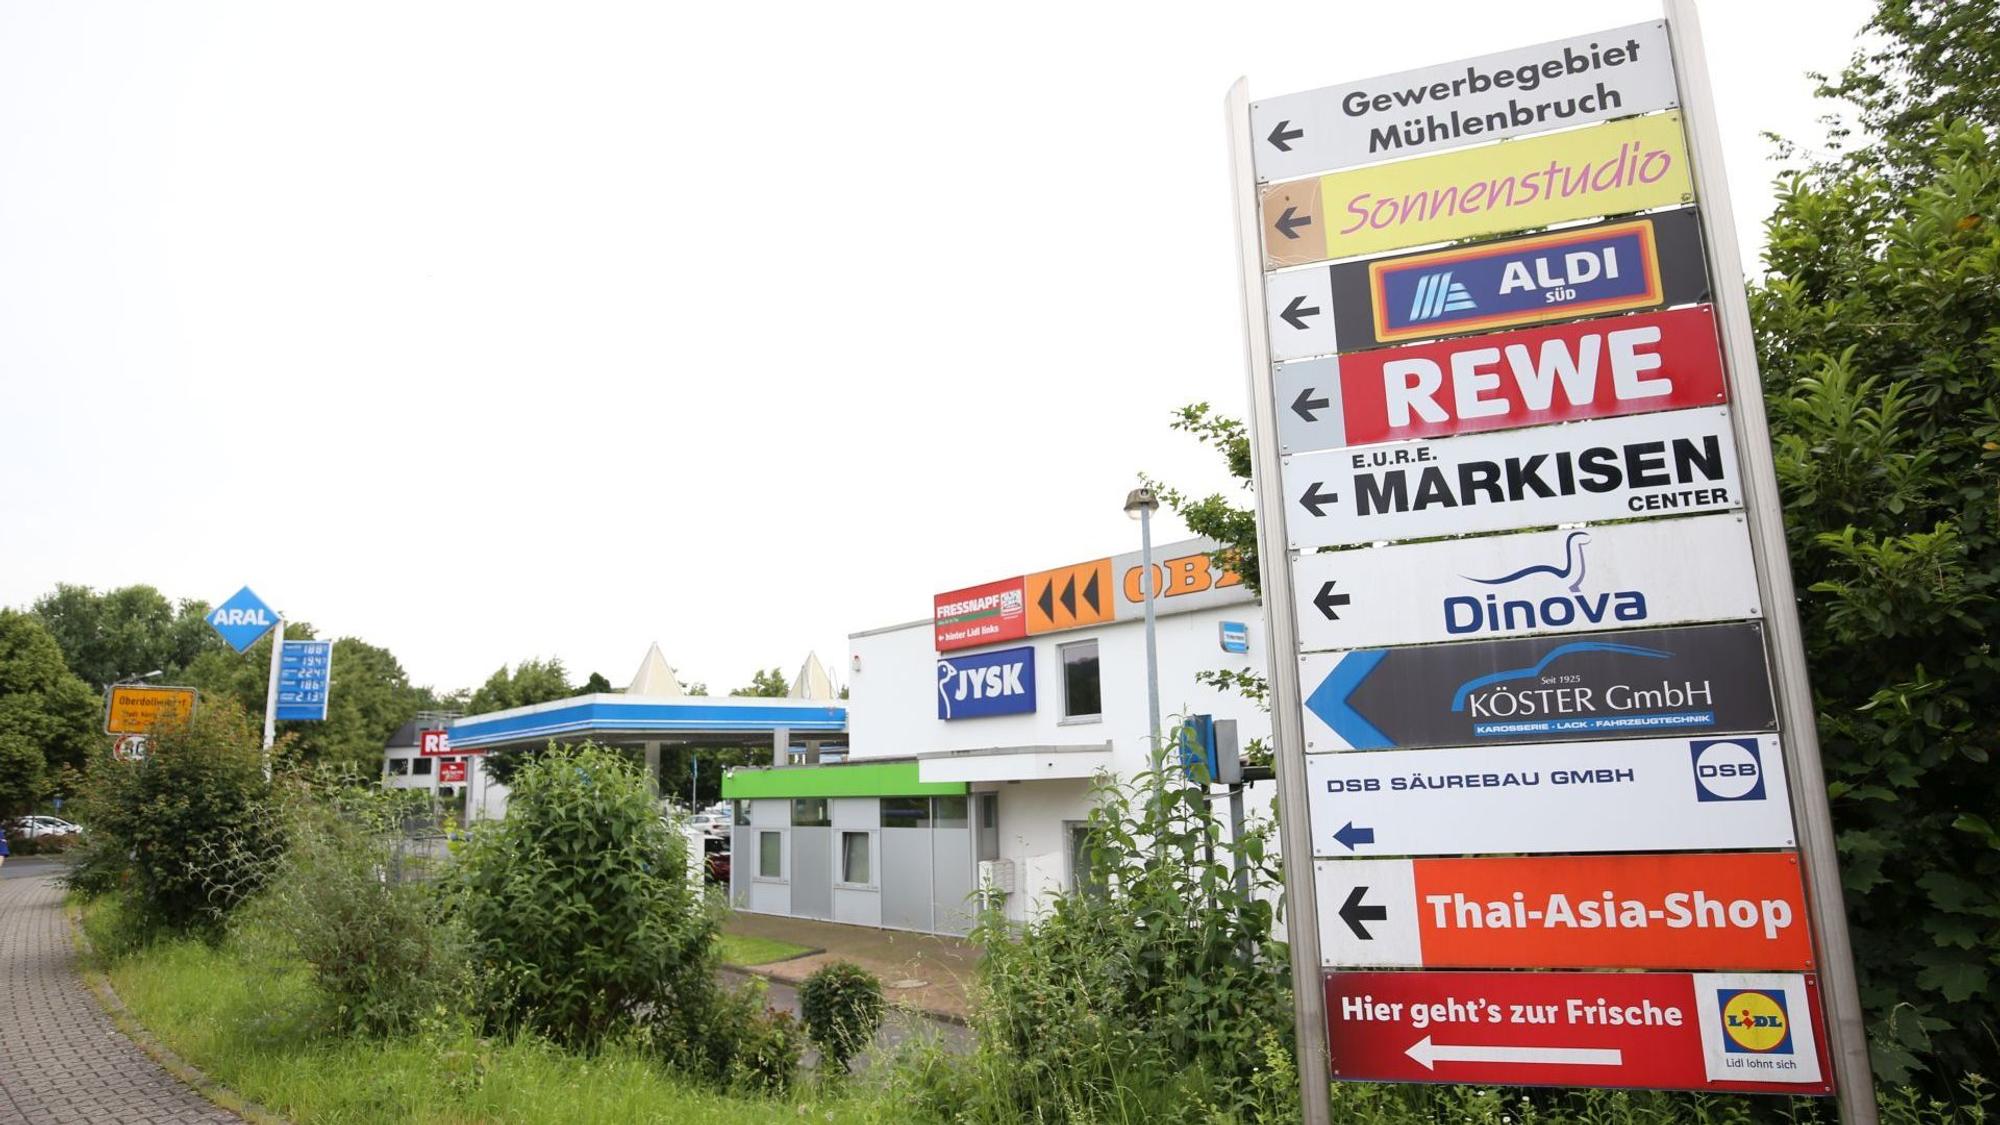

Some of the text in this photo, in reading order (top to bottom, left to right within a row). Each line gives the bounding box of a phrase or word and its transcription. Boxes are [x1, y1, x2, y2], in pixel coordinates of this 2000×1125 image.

[1342, 39, 1640, 117] Gewerbegebiet
[1368, 83, 1622, 153] Mühlenbruch
[1340, 141, 1672, 235] Sonnenstudio
[1499, 247, 1618, 294] ALDI
[1545, 287, 1576, 303] SÜD
[1383, 326, 1673, 427] REWE
[1352, 446, 1437, 469] E.U.R.E.
[1353, 434, 1725, 516] MARKISEN
[1628, 487, 1729, 512] CENTER
[213, 608, 270, 625] ARAL
[937, 594, 999, 618] FRESSNAPF
[1444, 589, 1647, 635] Dinova
[945, 625, 999, 641] hinter Lidl links
[955, 662, 1025, 701] JYSK
[1541, 675, 1581, 684] Seit 1925
[1470, 680, 1713, 717] KÖSTER GmbH
[1477, 715, 1710, 733] KAROSSERIE LACK FAHRZEUGTECHNIK
[425, 734, 450, 752] RE
[1327, 768, 1634, 793] DSB SÄUREBAU GMBH
[1698, 763, 1757, 778] DSB
[1426, 890, 1792, 939] Thai-Asia-Shop
[1342, 997, 1403, 1021] Hier
[1510, 1003, 1558, 1025] zur
[1567, 998, 1683, 1027] Frische
[1726, 1059, 1797, 1069] Lidl lohnt sich
